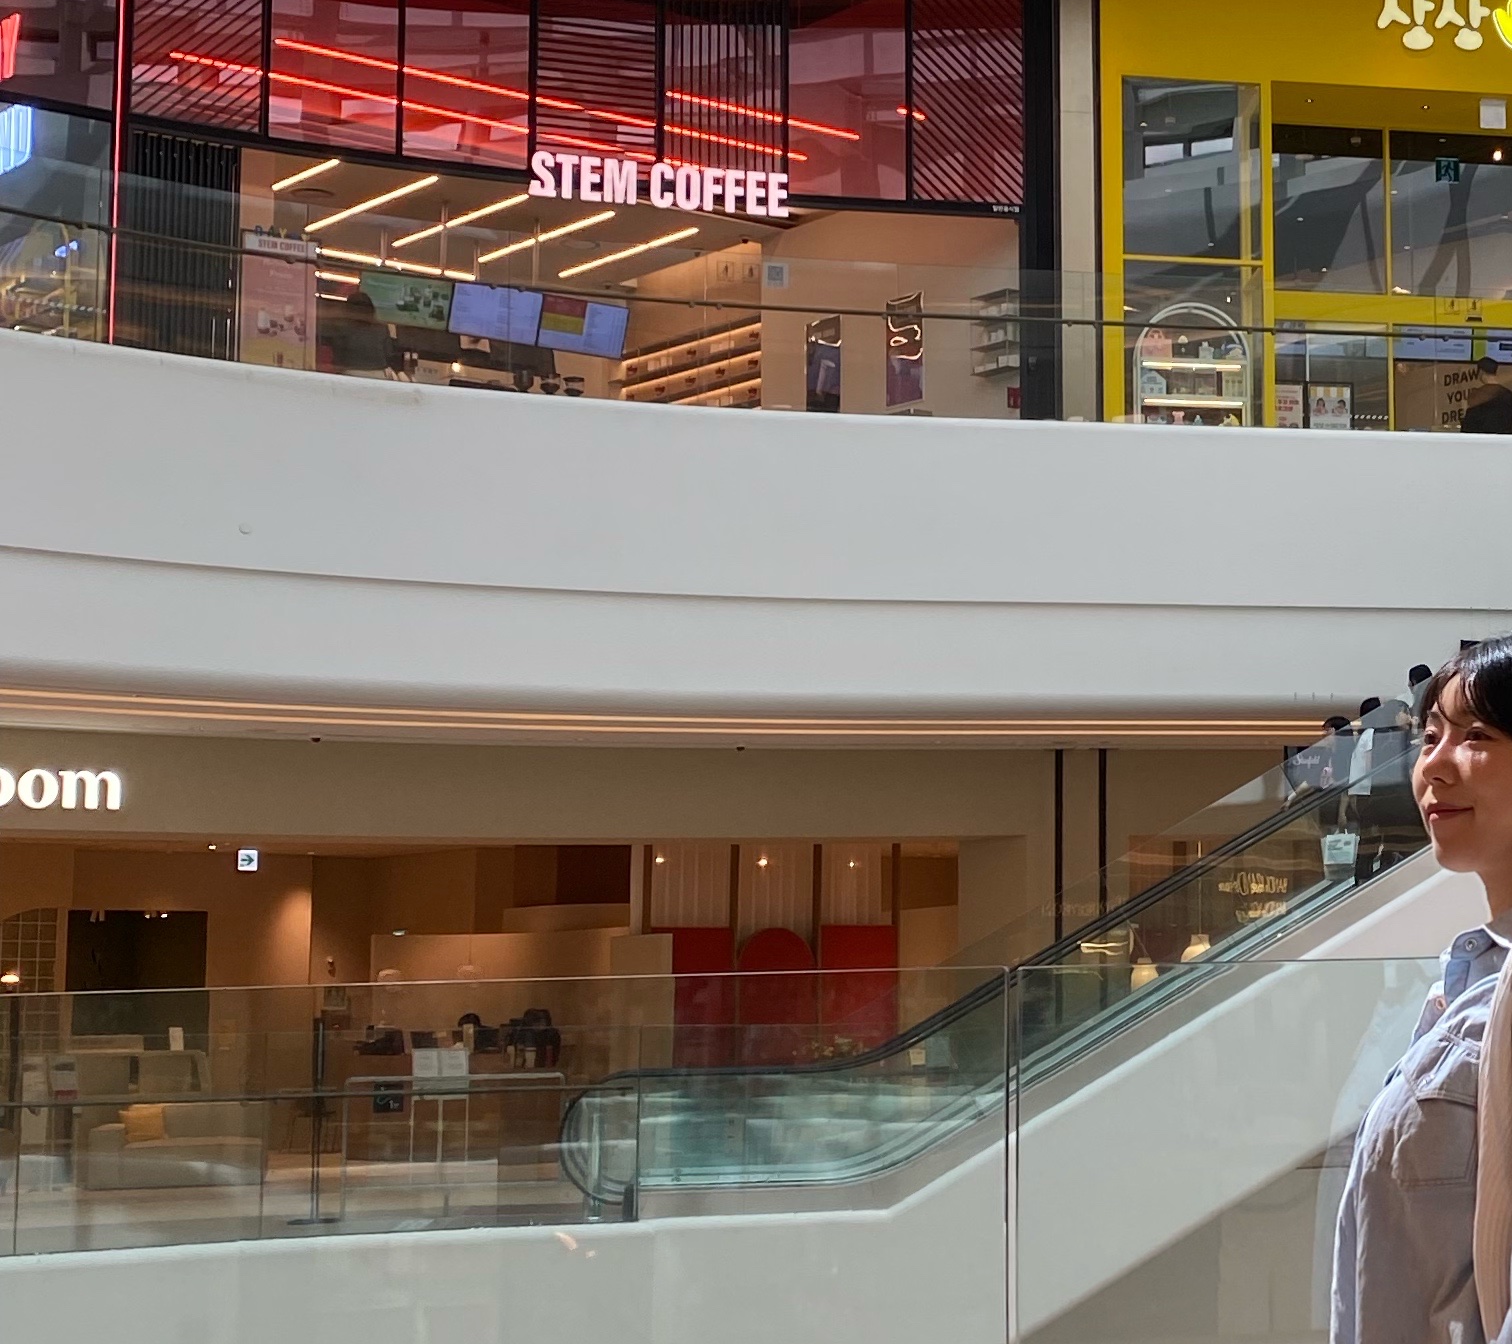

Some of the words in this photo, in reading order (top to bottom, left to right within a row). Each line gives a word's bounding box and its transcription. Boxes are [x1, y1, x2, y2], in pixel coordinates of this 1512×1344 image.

[528, 150, 637, 205] STEM
[650, 162, 790, 218] COFFEE
[1444, 367, 1480, 387] DRAW
[1446, 389, 1474, 405] YOU
